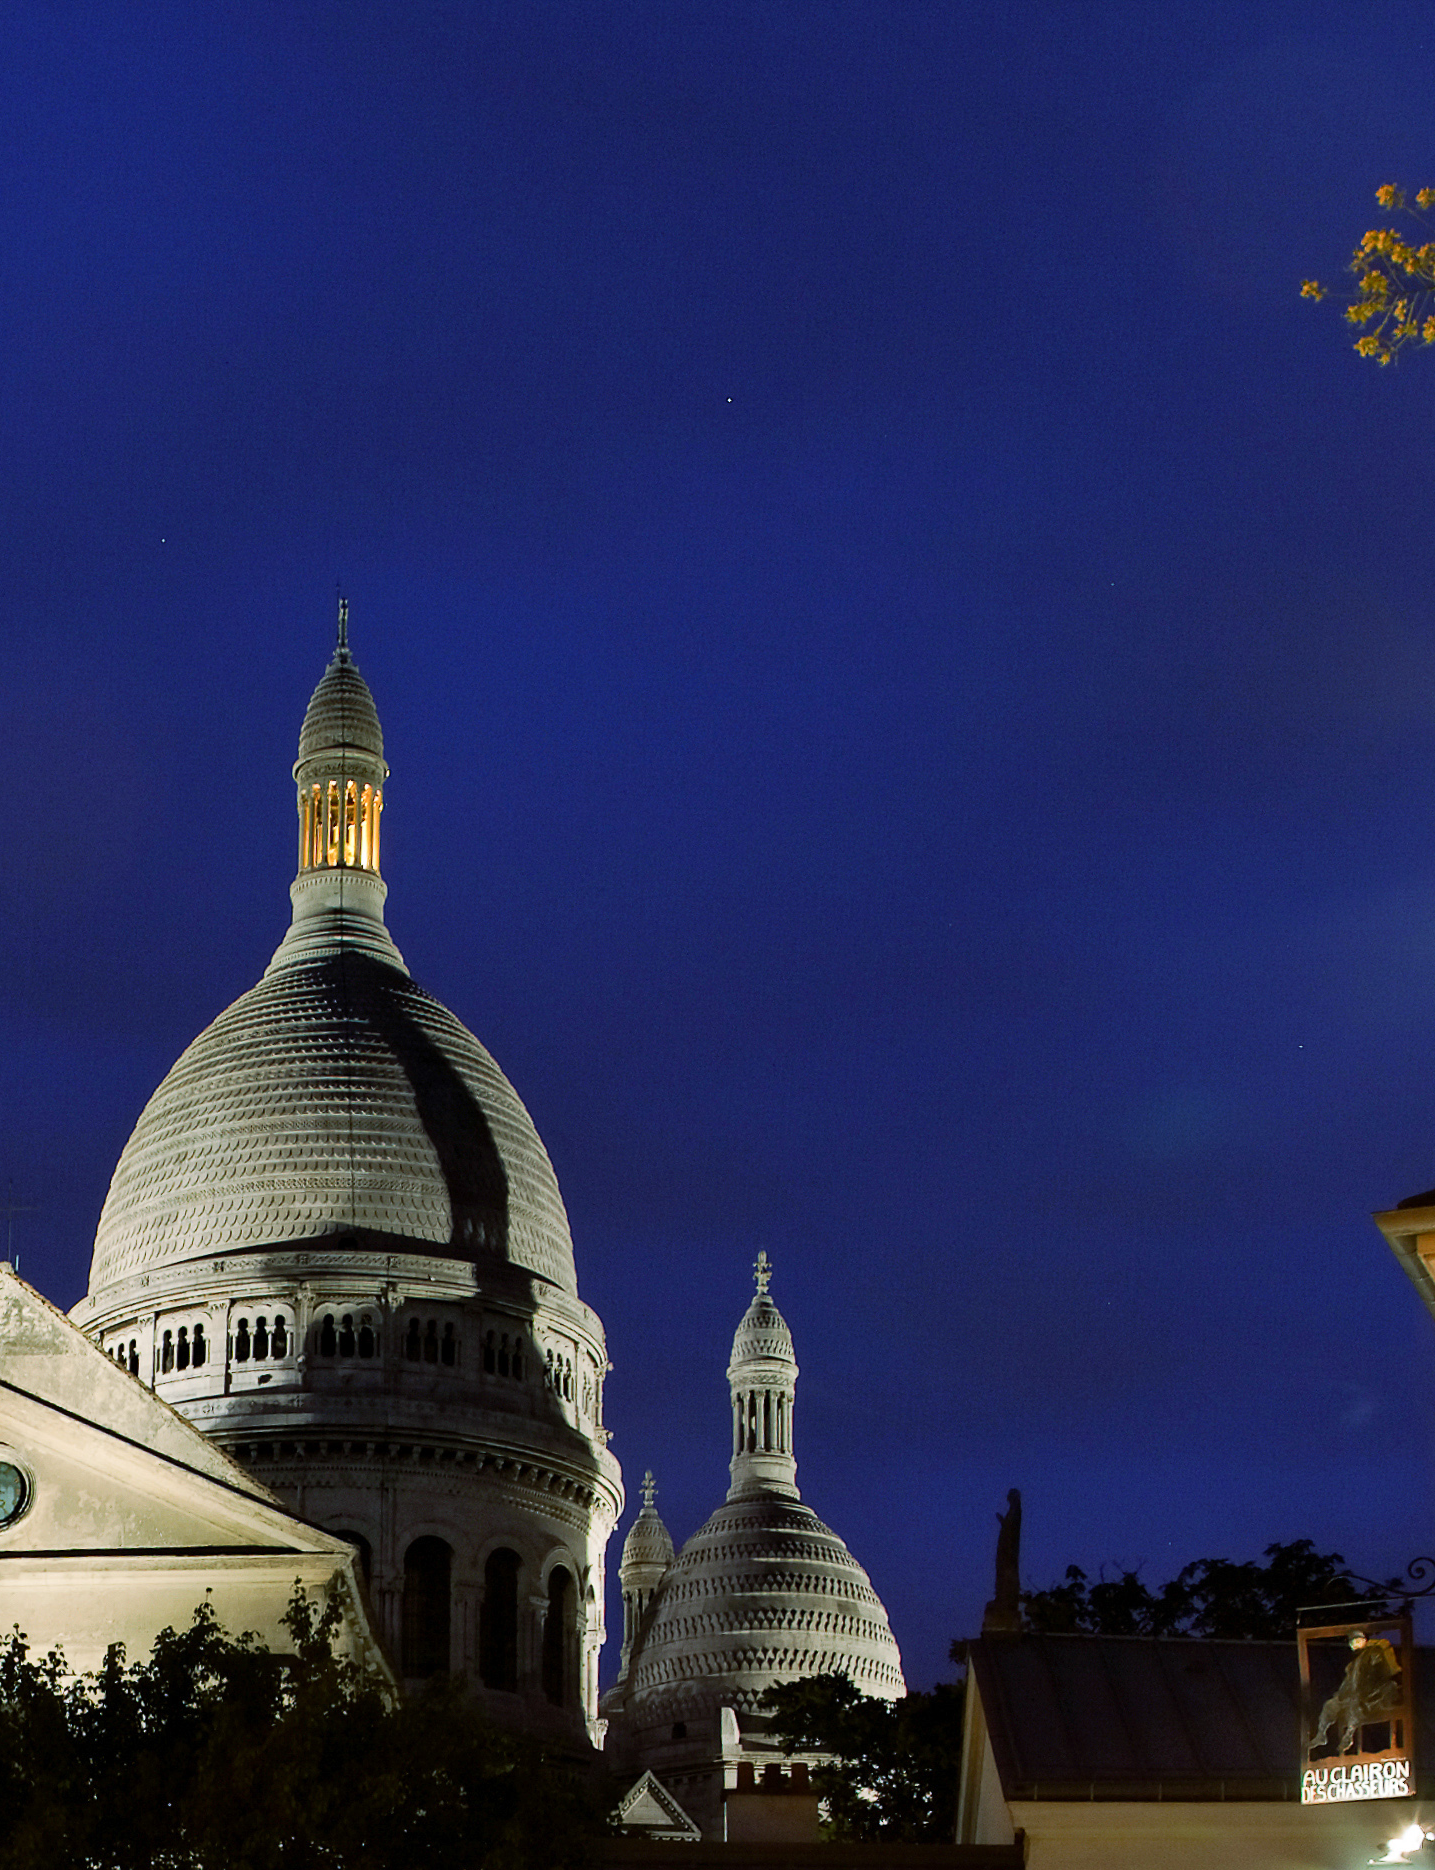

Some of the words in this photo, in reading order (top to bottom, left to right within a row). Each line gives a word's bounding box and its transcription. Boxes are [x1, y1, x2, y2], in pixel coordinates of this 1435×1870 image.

[1303, 1768, 1328, 1786] AU
[1330, 1761, 1410, 1784] CLAIRON
[1301, 1785, 1327, 1805] DES
[1327, 1778, 1409, 1801] CHASSEURS
